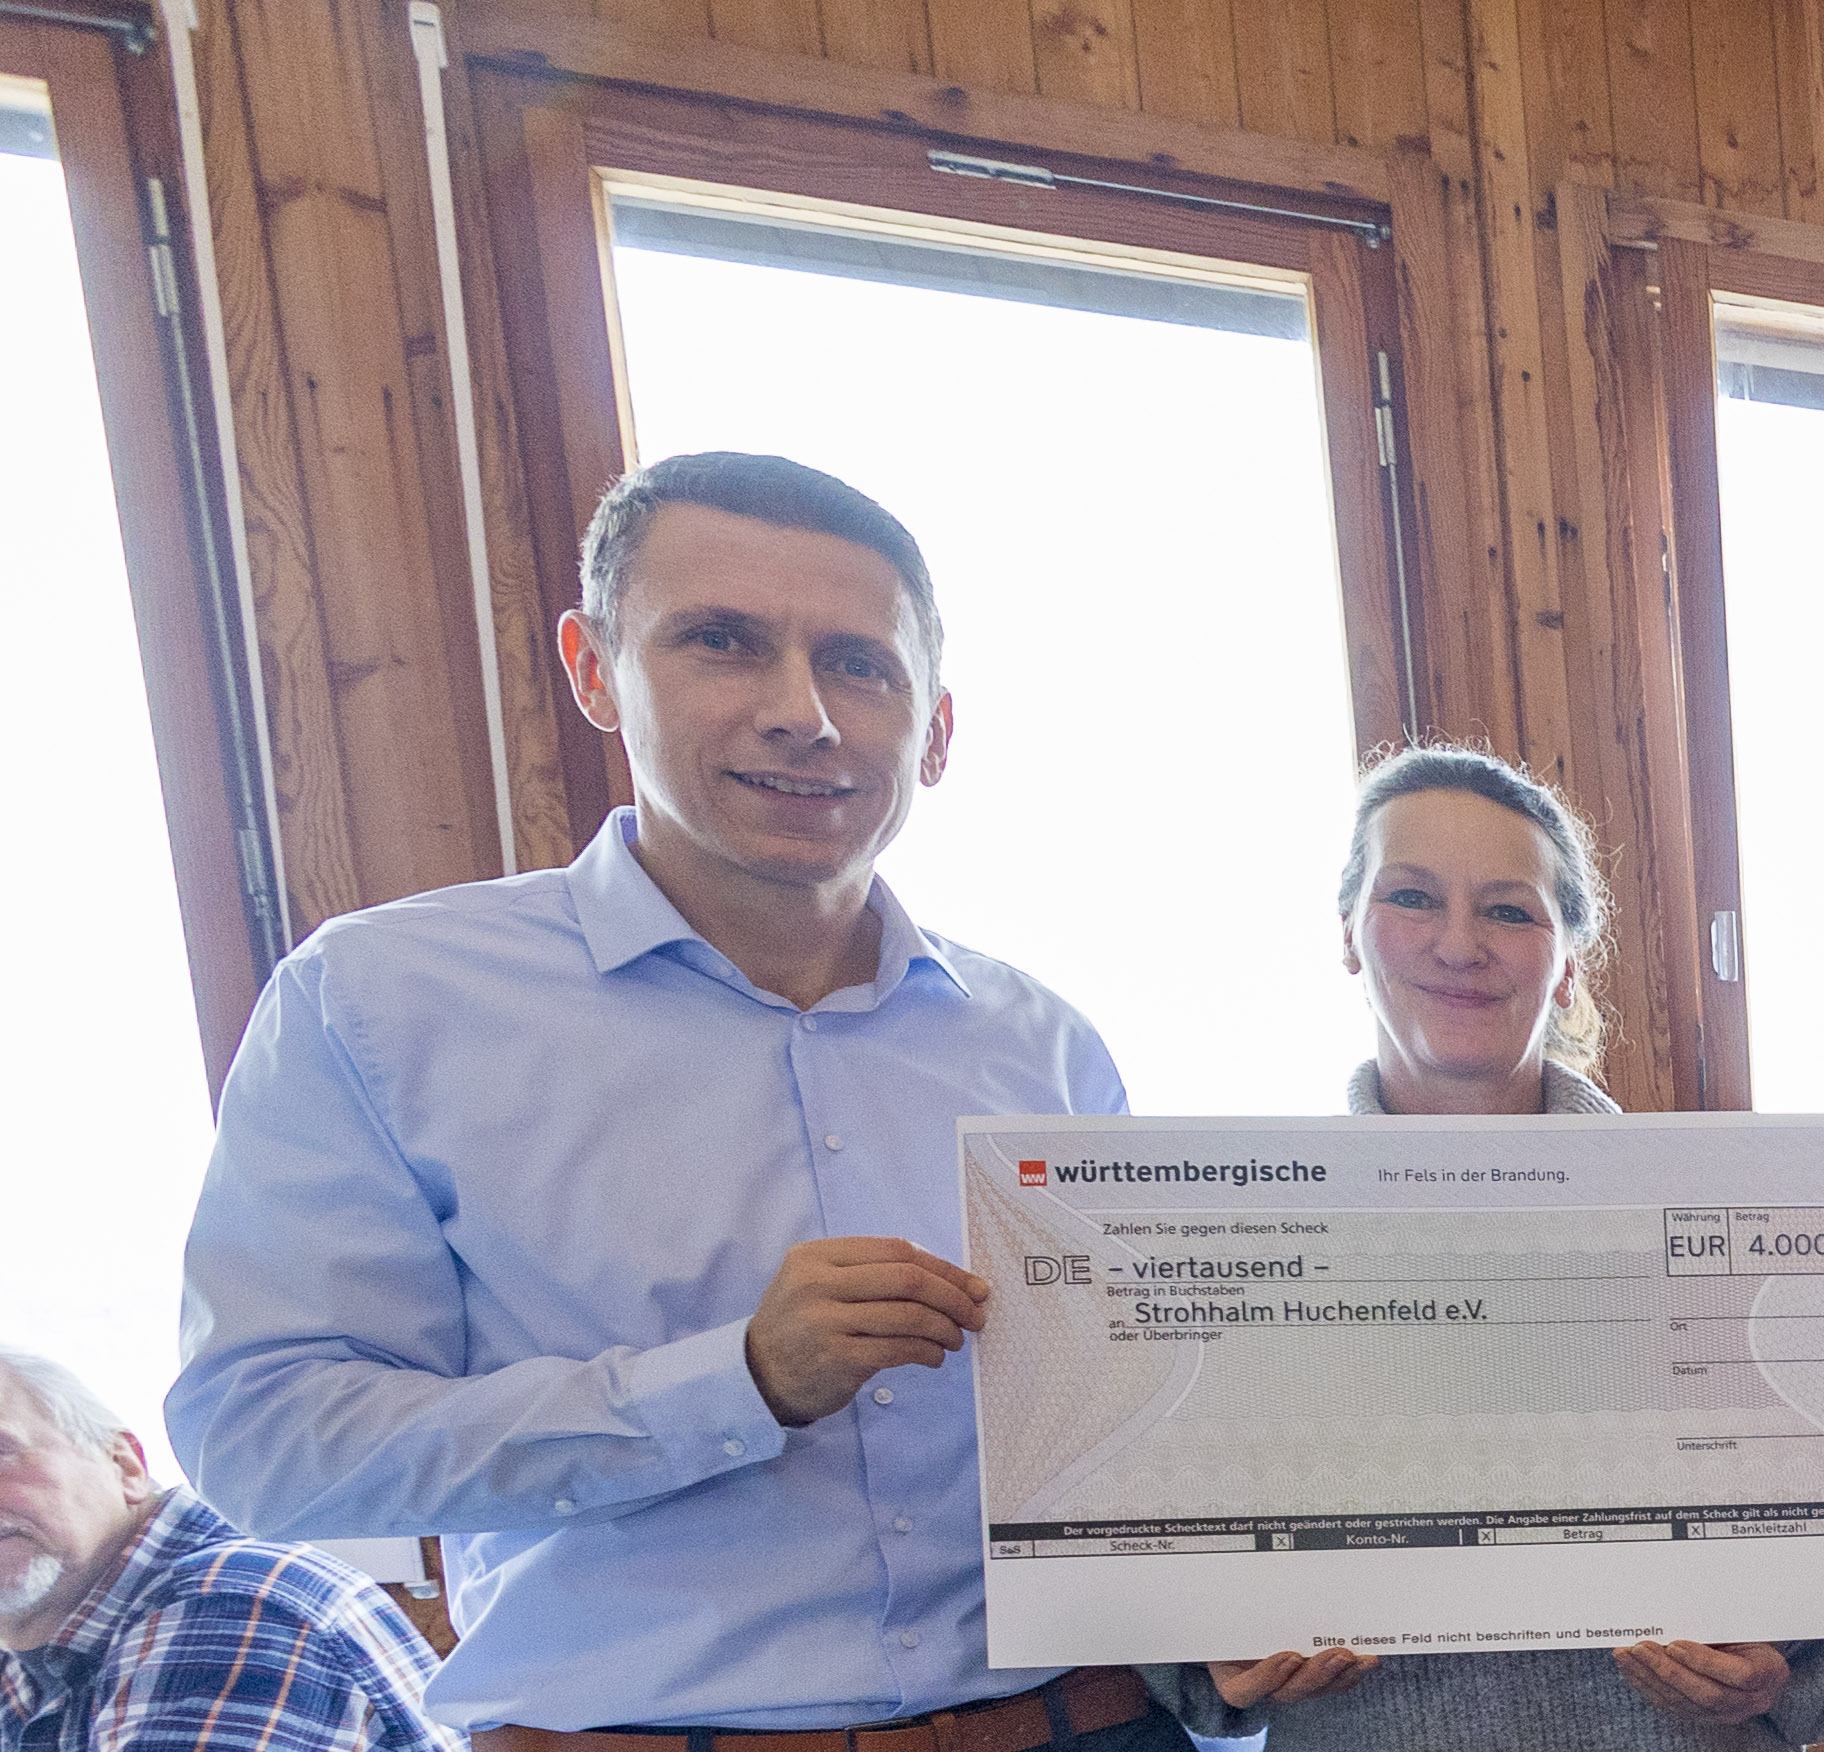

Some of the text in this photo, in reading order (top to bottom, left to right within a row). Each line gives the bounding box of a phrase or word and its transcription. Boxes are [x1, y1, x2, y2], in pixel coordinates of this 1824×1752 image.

[1055, 1160, 1326, 1186] württembergische
[1378, 1168, 1570, 1184] Ihr Fels in der Brandung.
[1672, 1212, 1769, 1224] Währung Betrag
[1103, 1222, 1328, 1236] Zahlen Sie gegen diesen Scheck
[1670, 1236, 1725, 1257] EUR
[1025, 1256, 1091, 1285] DE
[1134, 1256, 1303, 1278] viertausend
[1108, 1285, 1245, 1298] Betrag in Buchstaben
[1110, 1300, 1486, 1328] an Strohhalm Huchenfeld e.V.
[1671, 1322, 1687, 1331] Ort
[1110, 1329, 1222, 1343] oder Überbringer
[1673, 1366, 1707, 1375] Datum
[1677, 1441, 1737, 1450] Unterschrift
[1064, 1526, 1083, 1536] Der
[1087, 1524, 1161, 1536] vorgedruckte
[1165, 1523, 1226, 1533] Schecktext
[1230, 1521, 1253, 1532] darf
[1257, 1521, 1285, 1531] nicht
[1290, 1520, 1341, 1532] geändert
[1345, 1519, 1371, 1528] oder
[1375, 1517, 1433, 1530] gestrichen
[1438, 1516, 1482, 1526] werden.
[1487, 1515, 1503, 1524] Die
[1508, 1515, 1548, 1526] Angabe
[1553, 1513, 1578, 1523] einer
[1583, 1512, 1651, 1524] Zahlungsfrist
[1656, 1510, 1672, 1520] auf
[1676, 1510, 1699, 1519] dem
[1704, 1508, 1738, 1518] Scheck
[1743, 1507, 1761, 1520] gilt
[1765, 1507, 1779, 1516] als
[1782, 1506, 1808, 1516] nicht
[1110, 1540, 1174, 1552] Scheck-Nr.
[1346, 1534, 1409, 1545] Konto-Nr.
[1563, 1530, 1603, 1540] Betrag
[1731, 1522, 1806, 1534] Bankleitzahl
[1313, 1626, 1663, 1647] Bitte dieses Feld nicht beschriften und bestempeln
